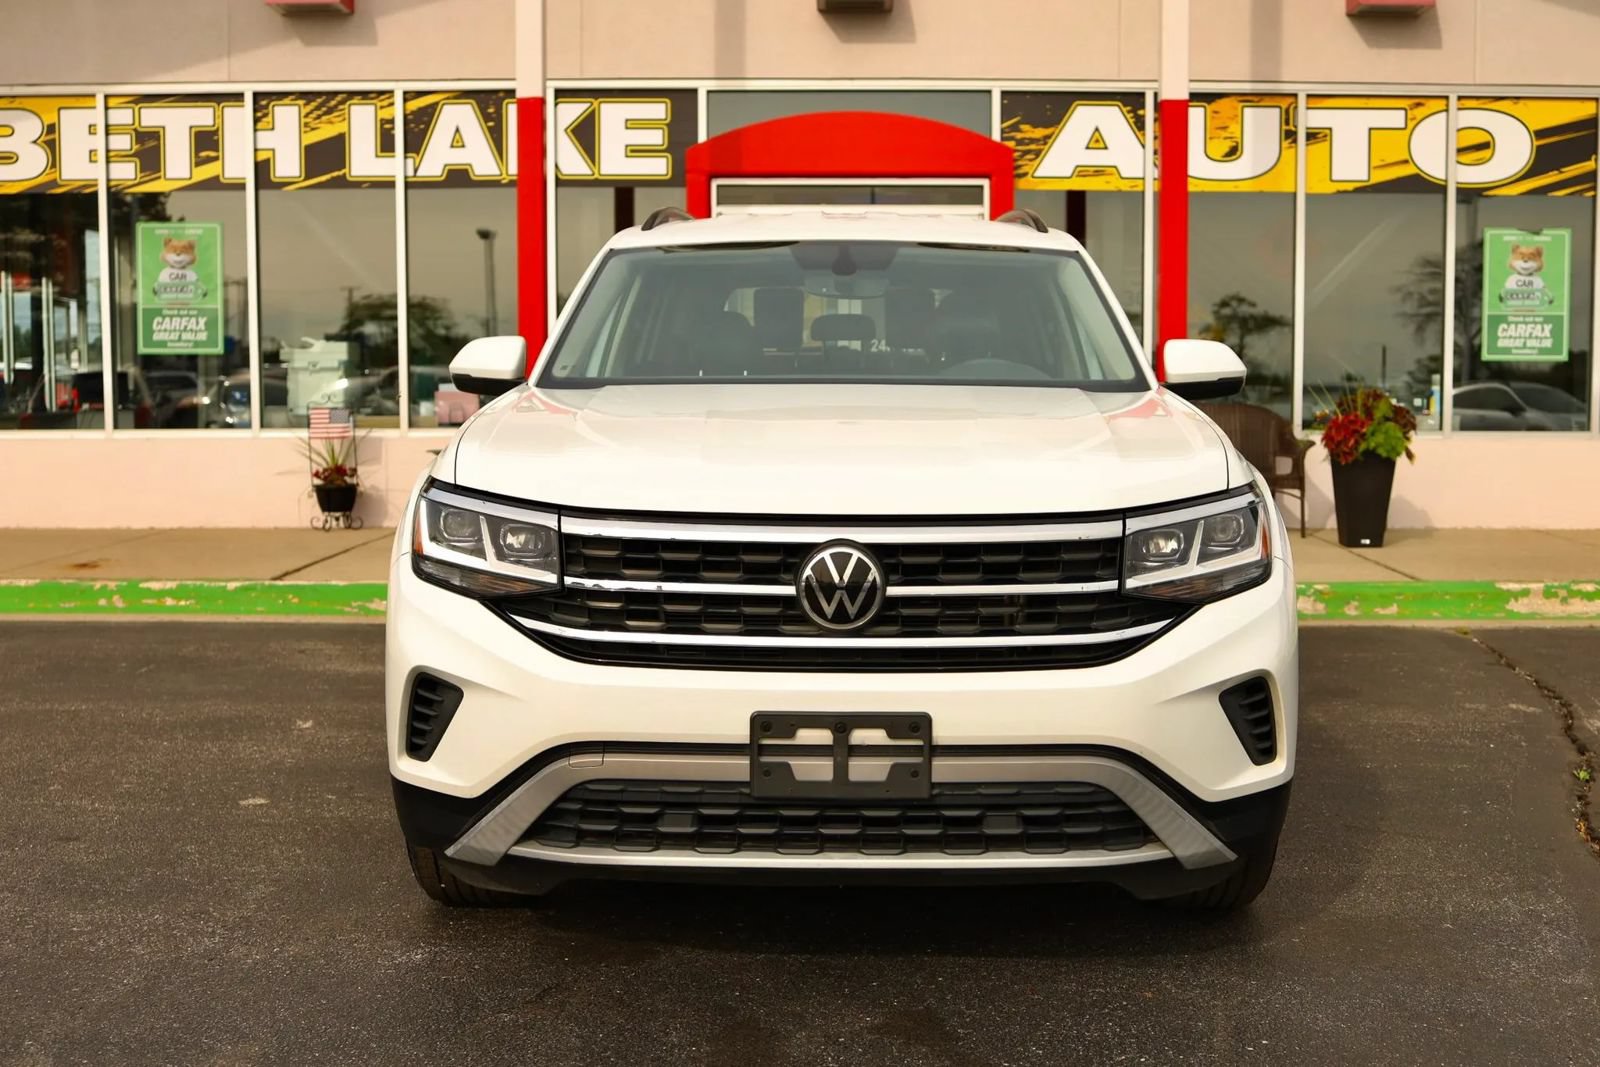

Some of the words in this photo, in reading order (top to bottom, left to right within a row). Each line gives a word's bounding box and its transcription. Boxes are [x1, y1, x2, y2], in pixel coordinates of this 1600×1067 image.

[0, 102, 305, 183] BETH
[346, 98, 671, 181] LAKE
[1031, 101, 1536, 188] AUTO
[152, 316, 207, 331] CARFAX
[1497, 323, 1552, 338] CARFAX
[801, 546, 881, 630] VW
